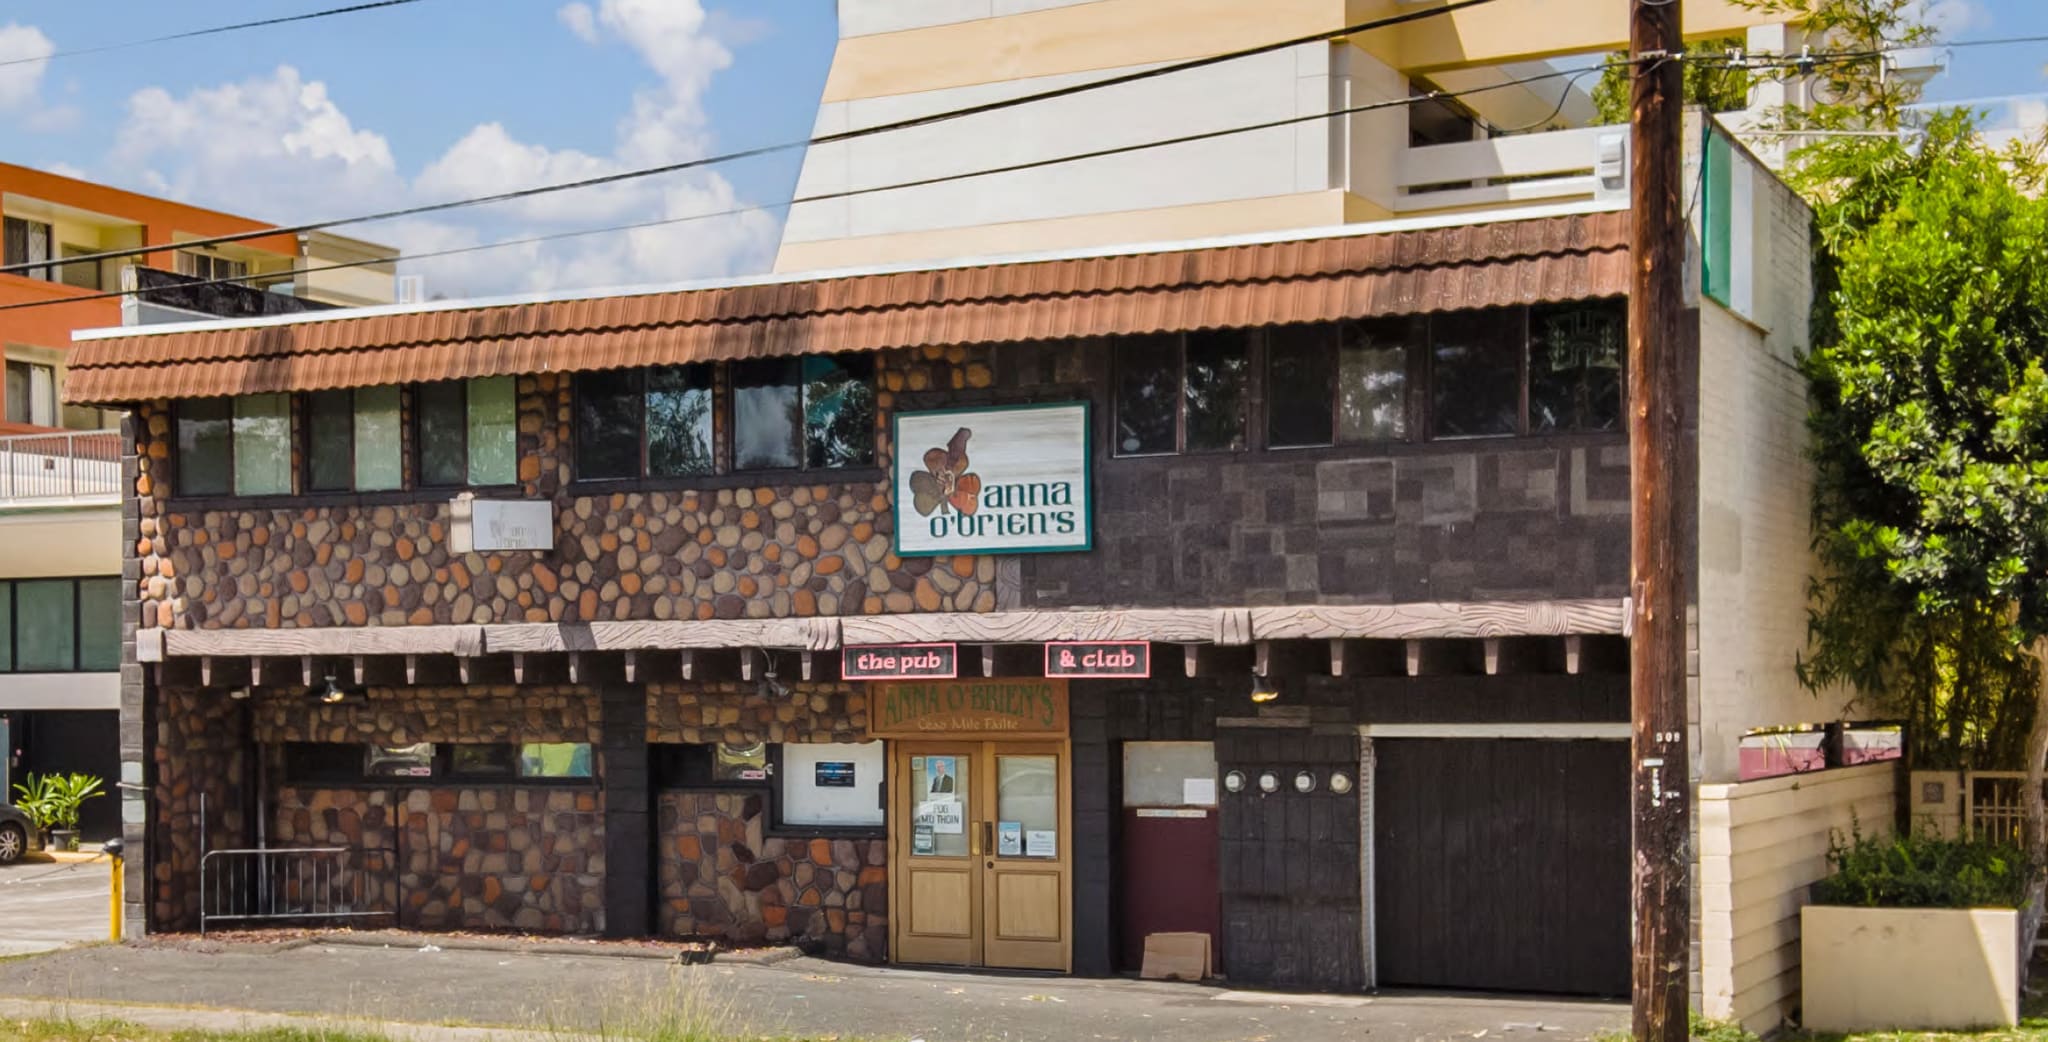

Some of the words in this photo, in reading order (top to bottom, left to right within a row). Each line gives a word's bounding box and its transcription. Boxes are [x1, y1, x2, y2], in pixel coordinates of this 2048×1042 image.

[984, 481, 1072, 508] anna
[930, 510, 1075, 538] o'brien's
[857, 653, 896, 670] the
[901, 651, 941, 673] pub
[1060, 649, 1077, 668] &
[1082, 648, 1136, 668] club
[884, 684, 940, 728] ANNA
[946, 683, 1055, 728] O'BRIEN'S
